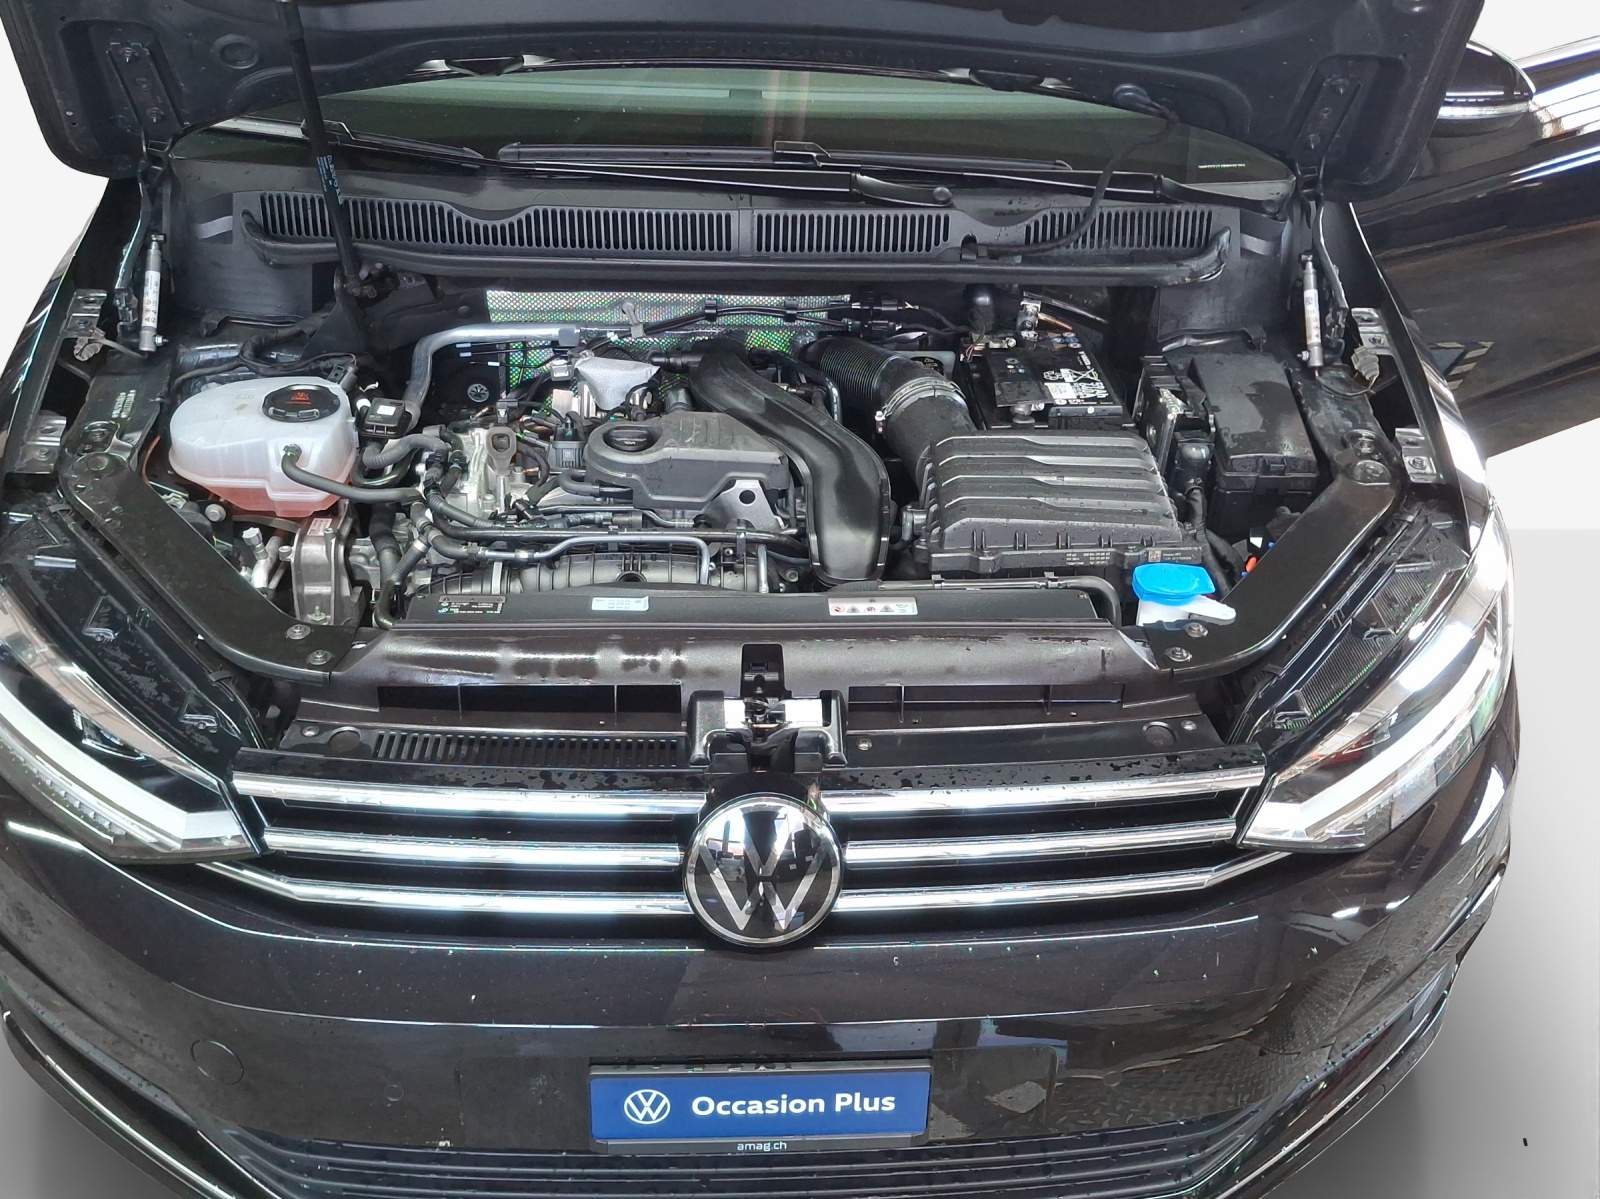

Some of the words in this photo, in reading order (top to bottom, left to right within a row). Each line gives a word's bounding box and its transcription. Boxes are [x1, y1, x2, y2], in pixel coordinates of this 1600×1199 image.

[696, 803, 831, 931] VW
[624, 1089, 671, 1125] VW
[691, 1093, 825, 1116] Occasion
[834, 1092, 896, 1112] Plus
[736, 1141, 787, 1152] amag.ch
